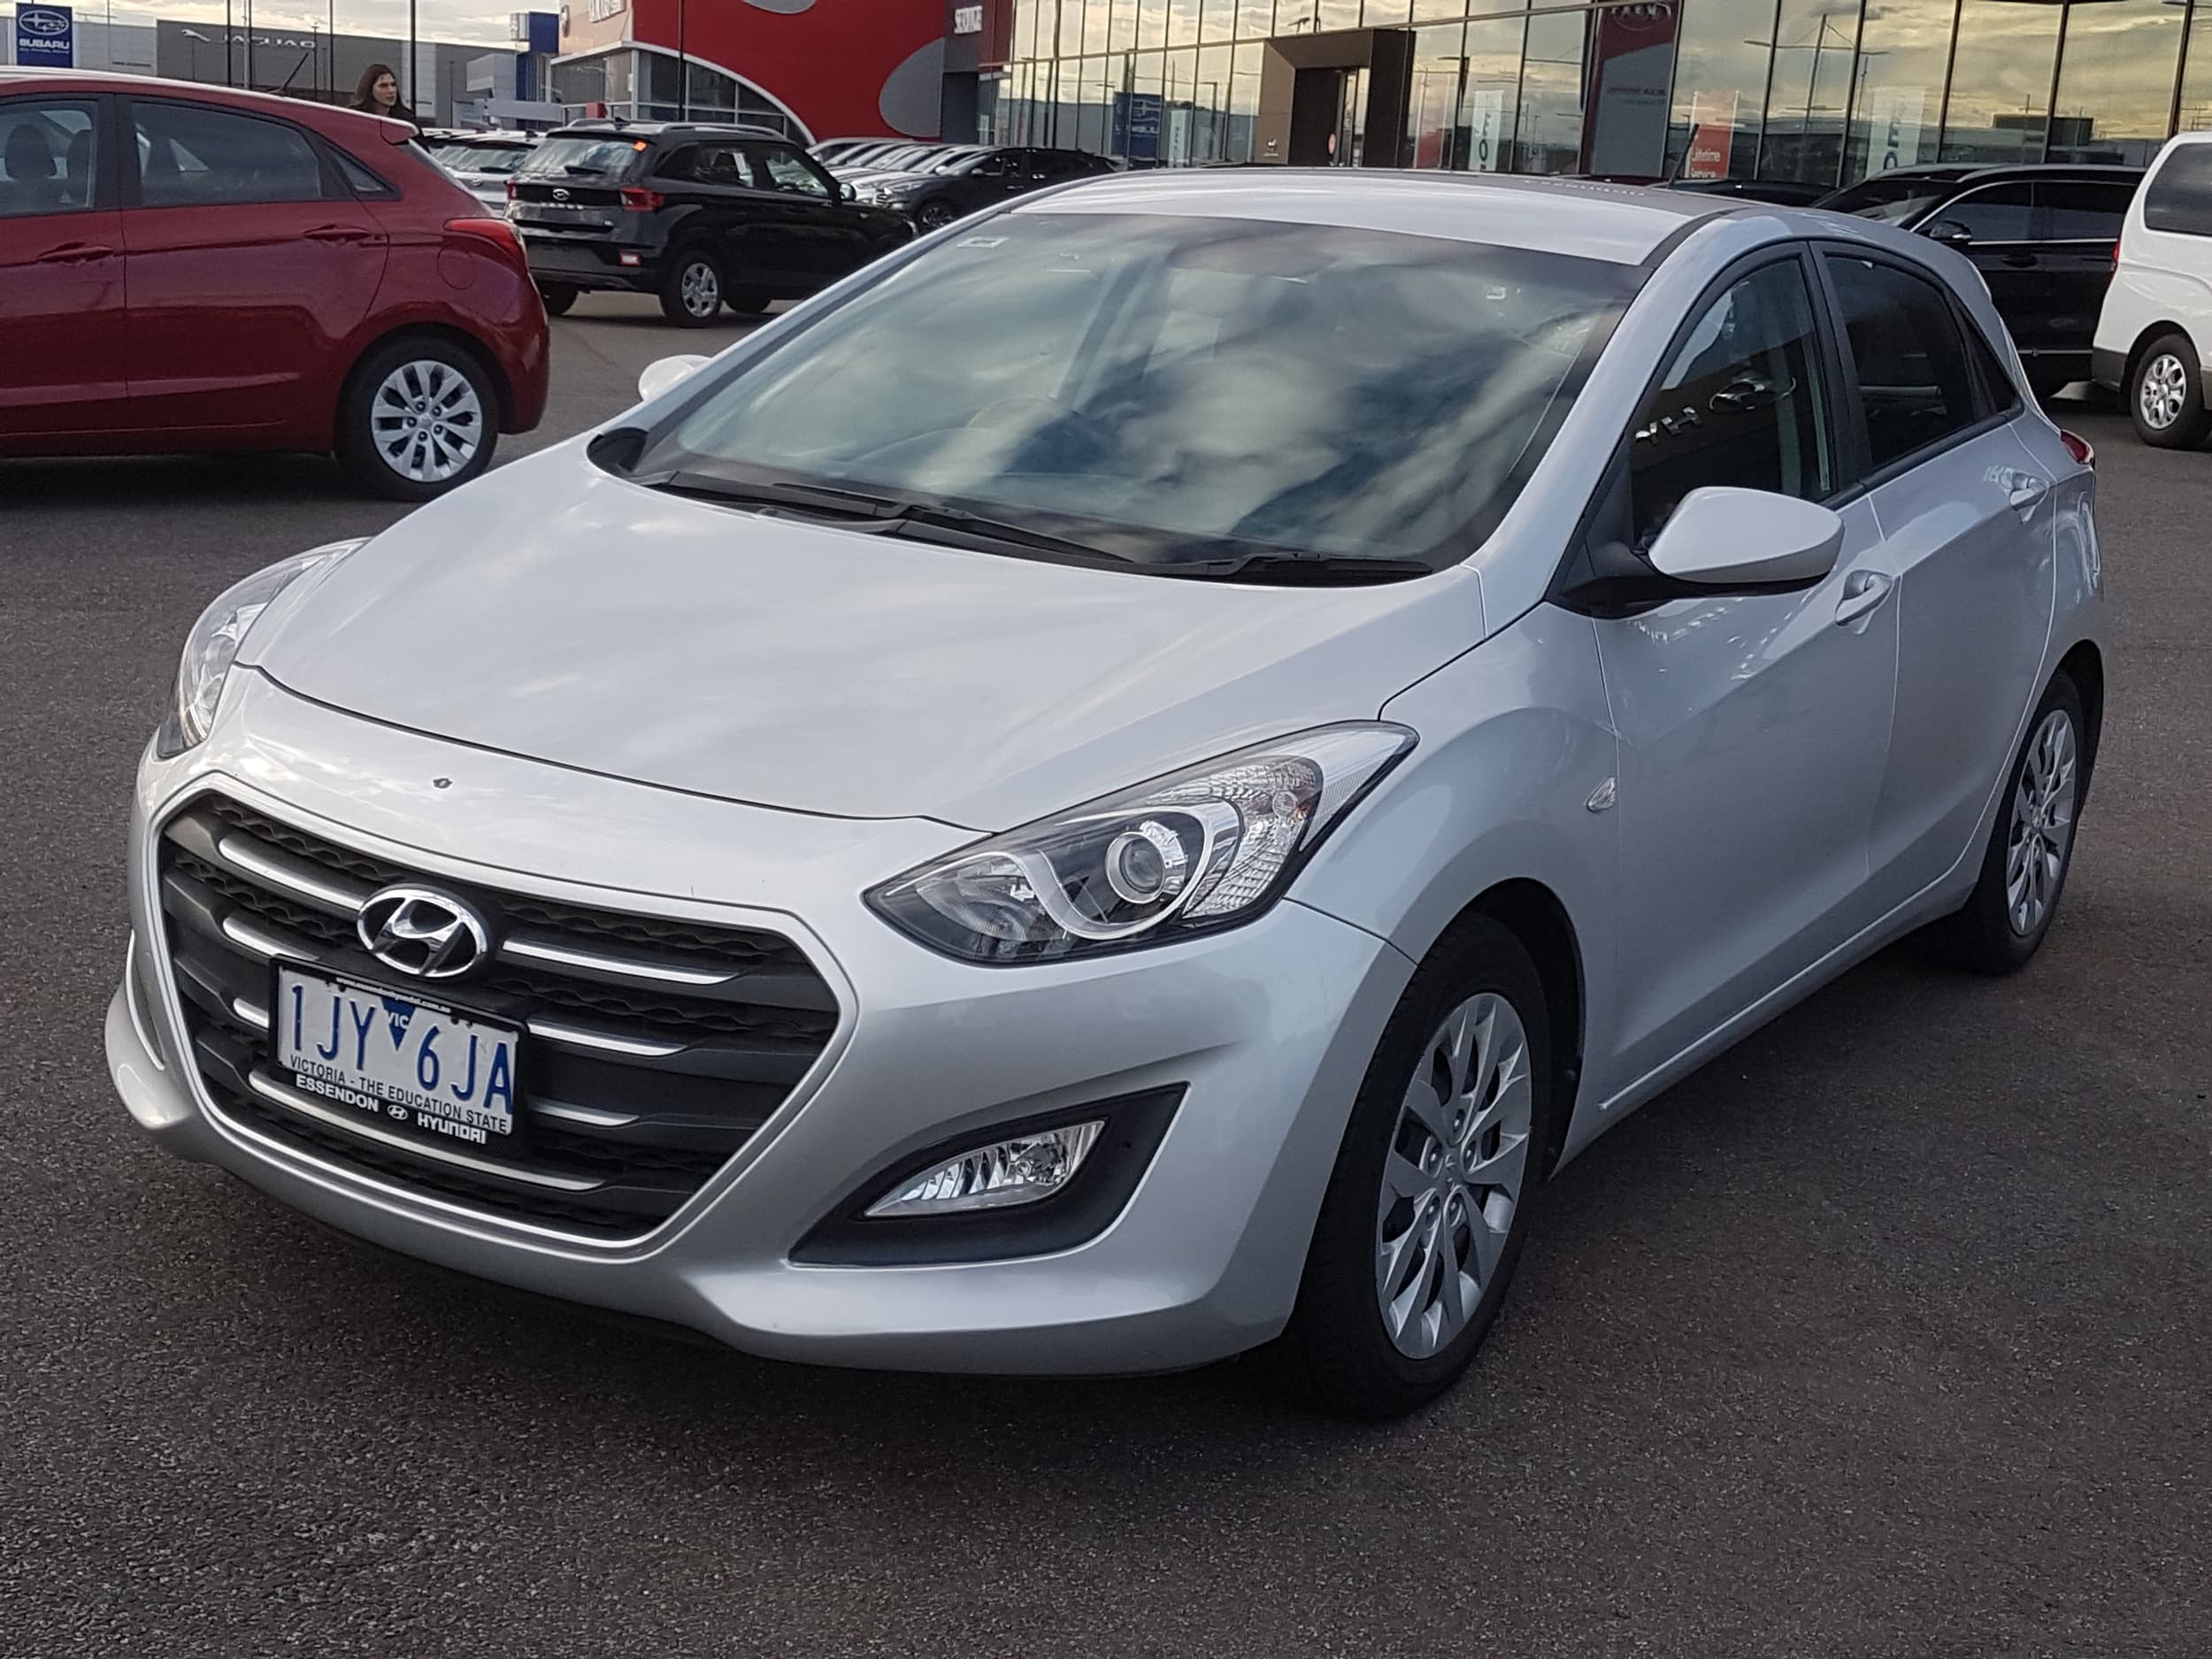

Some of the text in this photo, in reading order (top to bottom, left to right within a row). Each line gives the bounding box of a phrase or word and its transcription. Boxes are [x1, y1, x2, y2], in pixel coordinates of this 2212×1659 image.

[19, 38, 70, 50] SUBARU
[292, 985, 514, 1115] 1JY 6JA
[387, 1010, 411, 1030] VIC
[290, 1054, 346, 1086] VICTORIA
[358, 1076, 384, 1096] THE
[388, 1087, 463, 1118] EDUCATION
[466, 1110, 509, 1134] STATE
[296, 1073, 488, 1145] ESSENDON HYUNDAI
